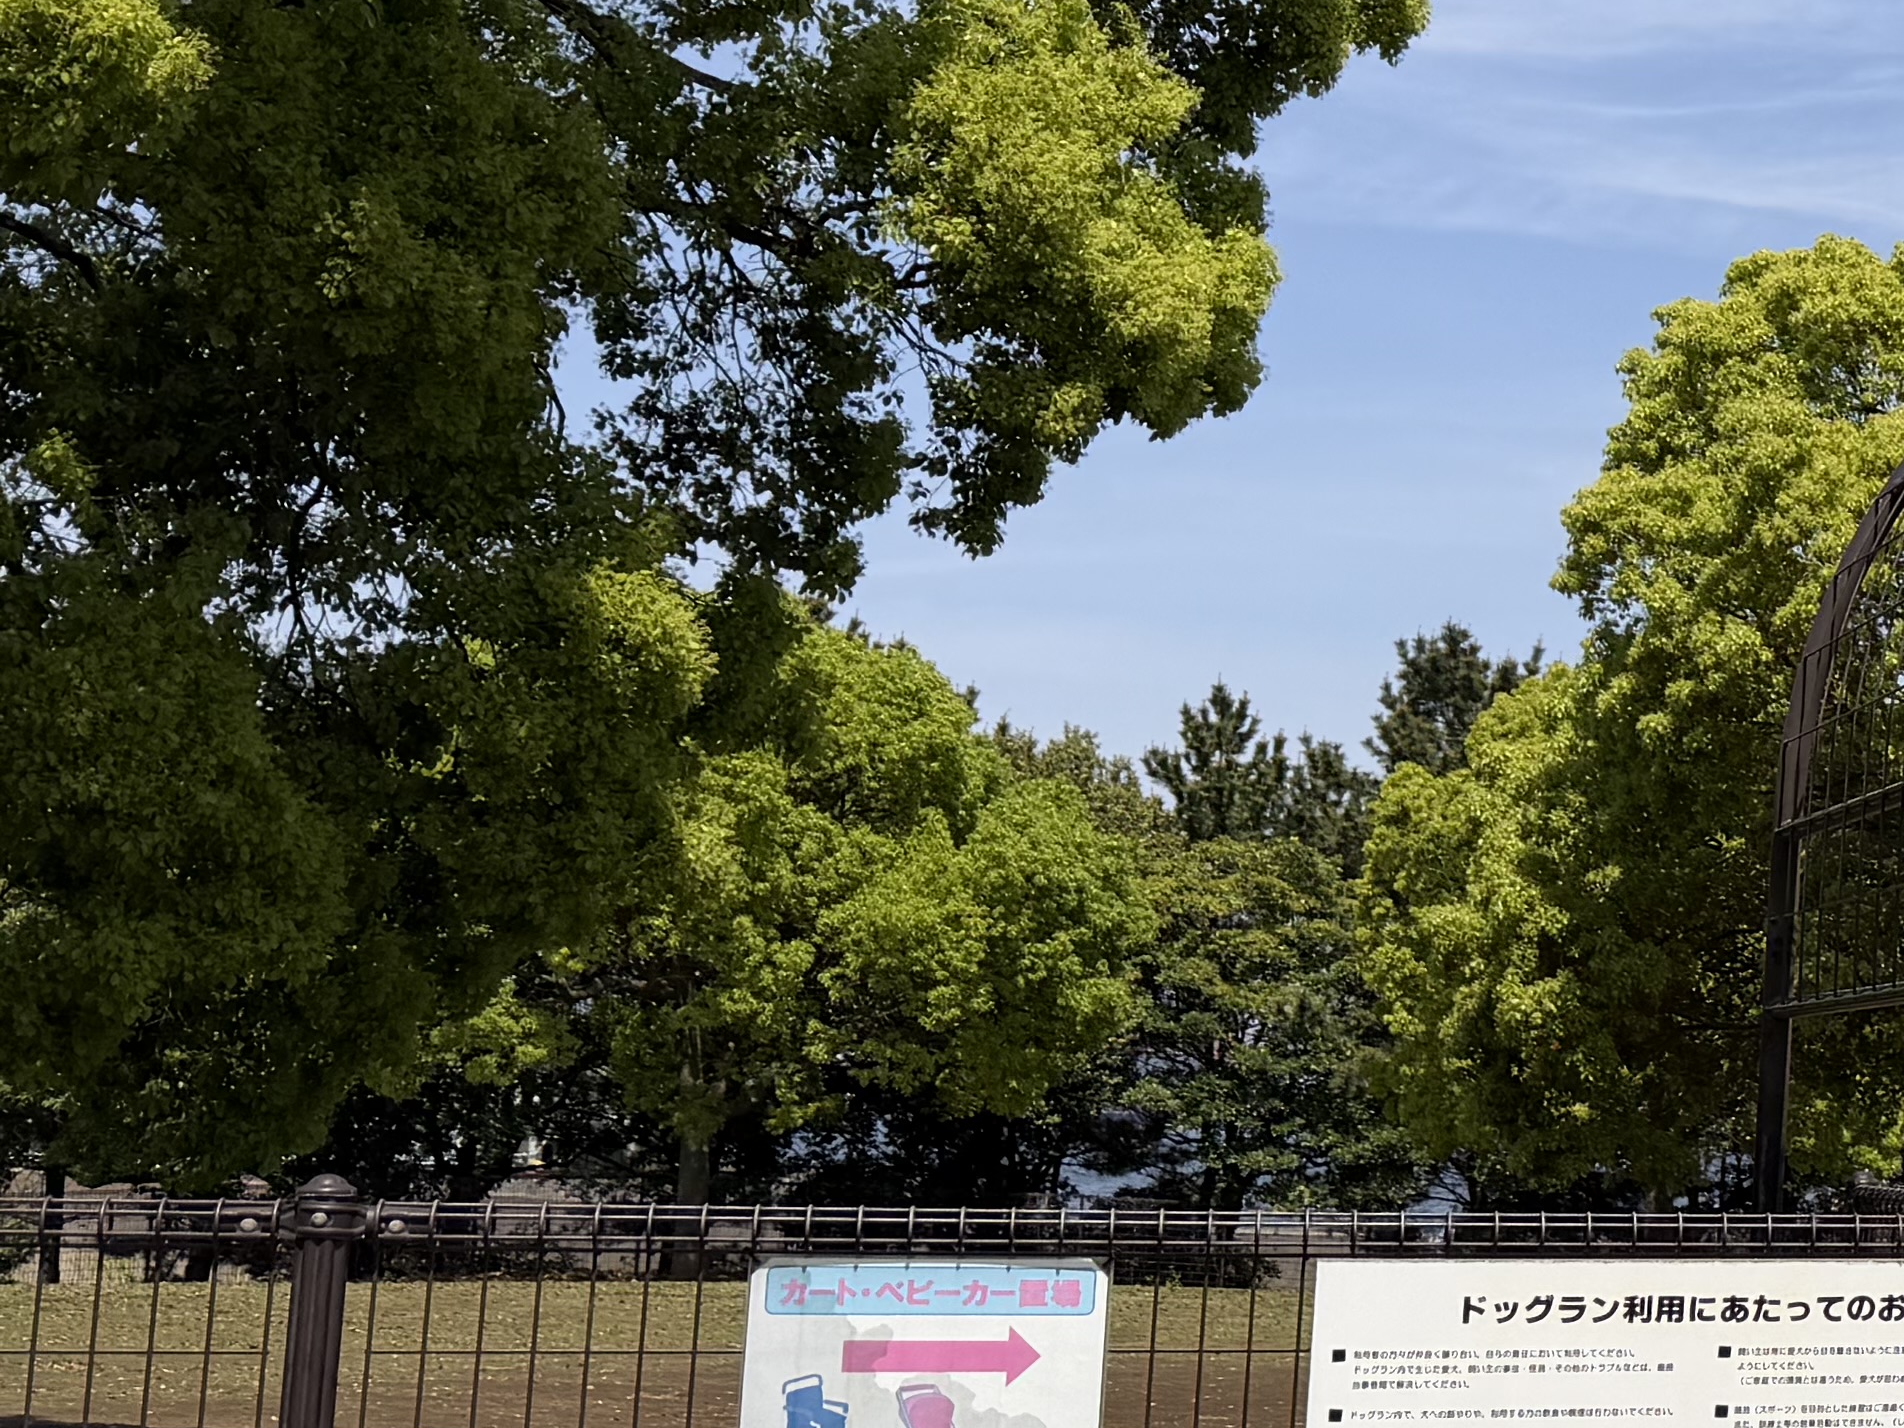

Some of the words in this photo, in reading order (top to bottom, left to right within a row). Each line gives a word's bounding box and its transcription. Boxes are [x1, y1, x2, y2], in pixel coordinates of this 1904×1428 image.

[779, 1278, 1082, 1309] カート・ベビーカー置場
